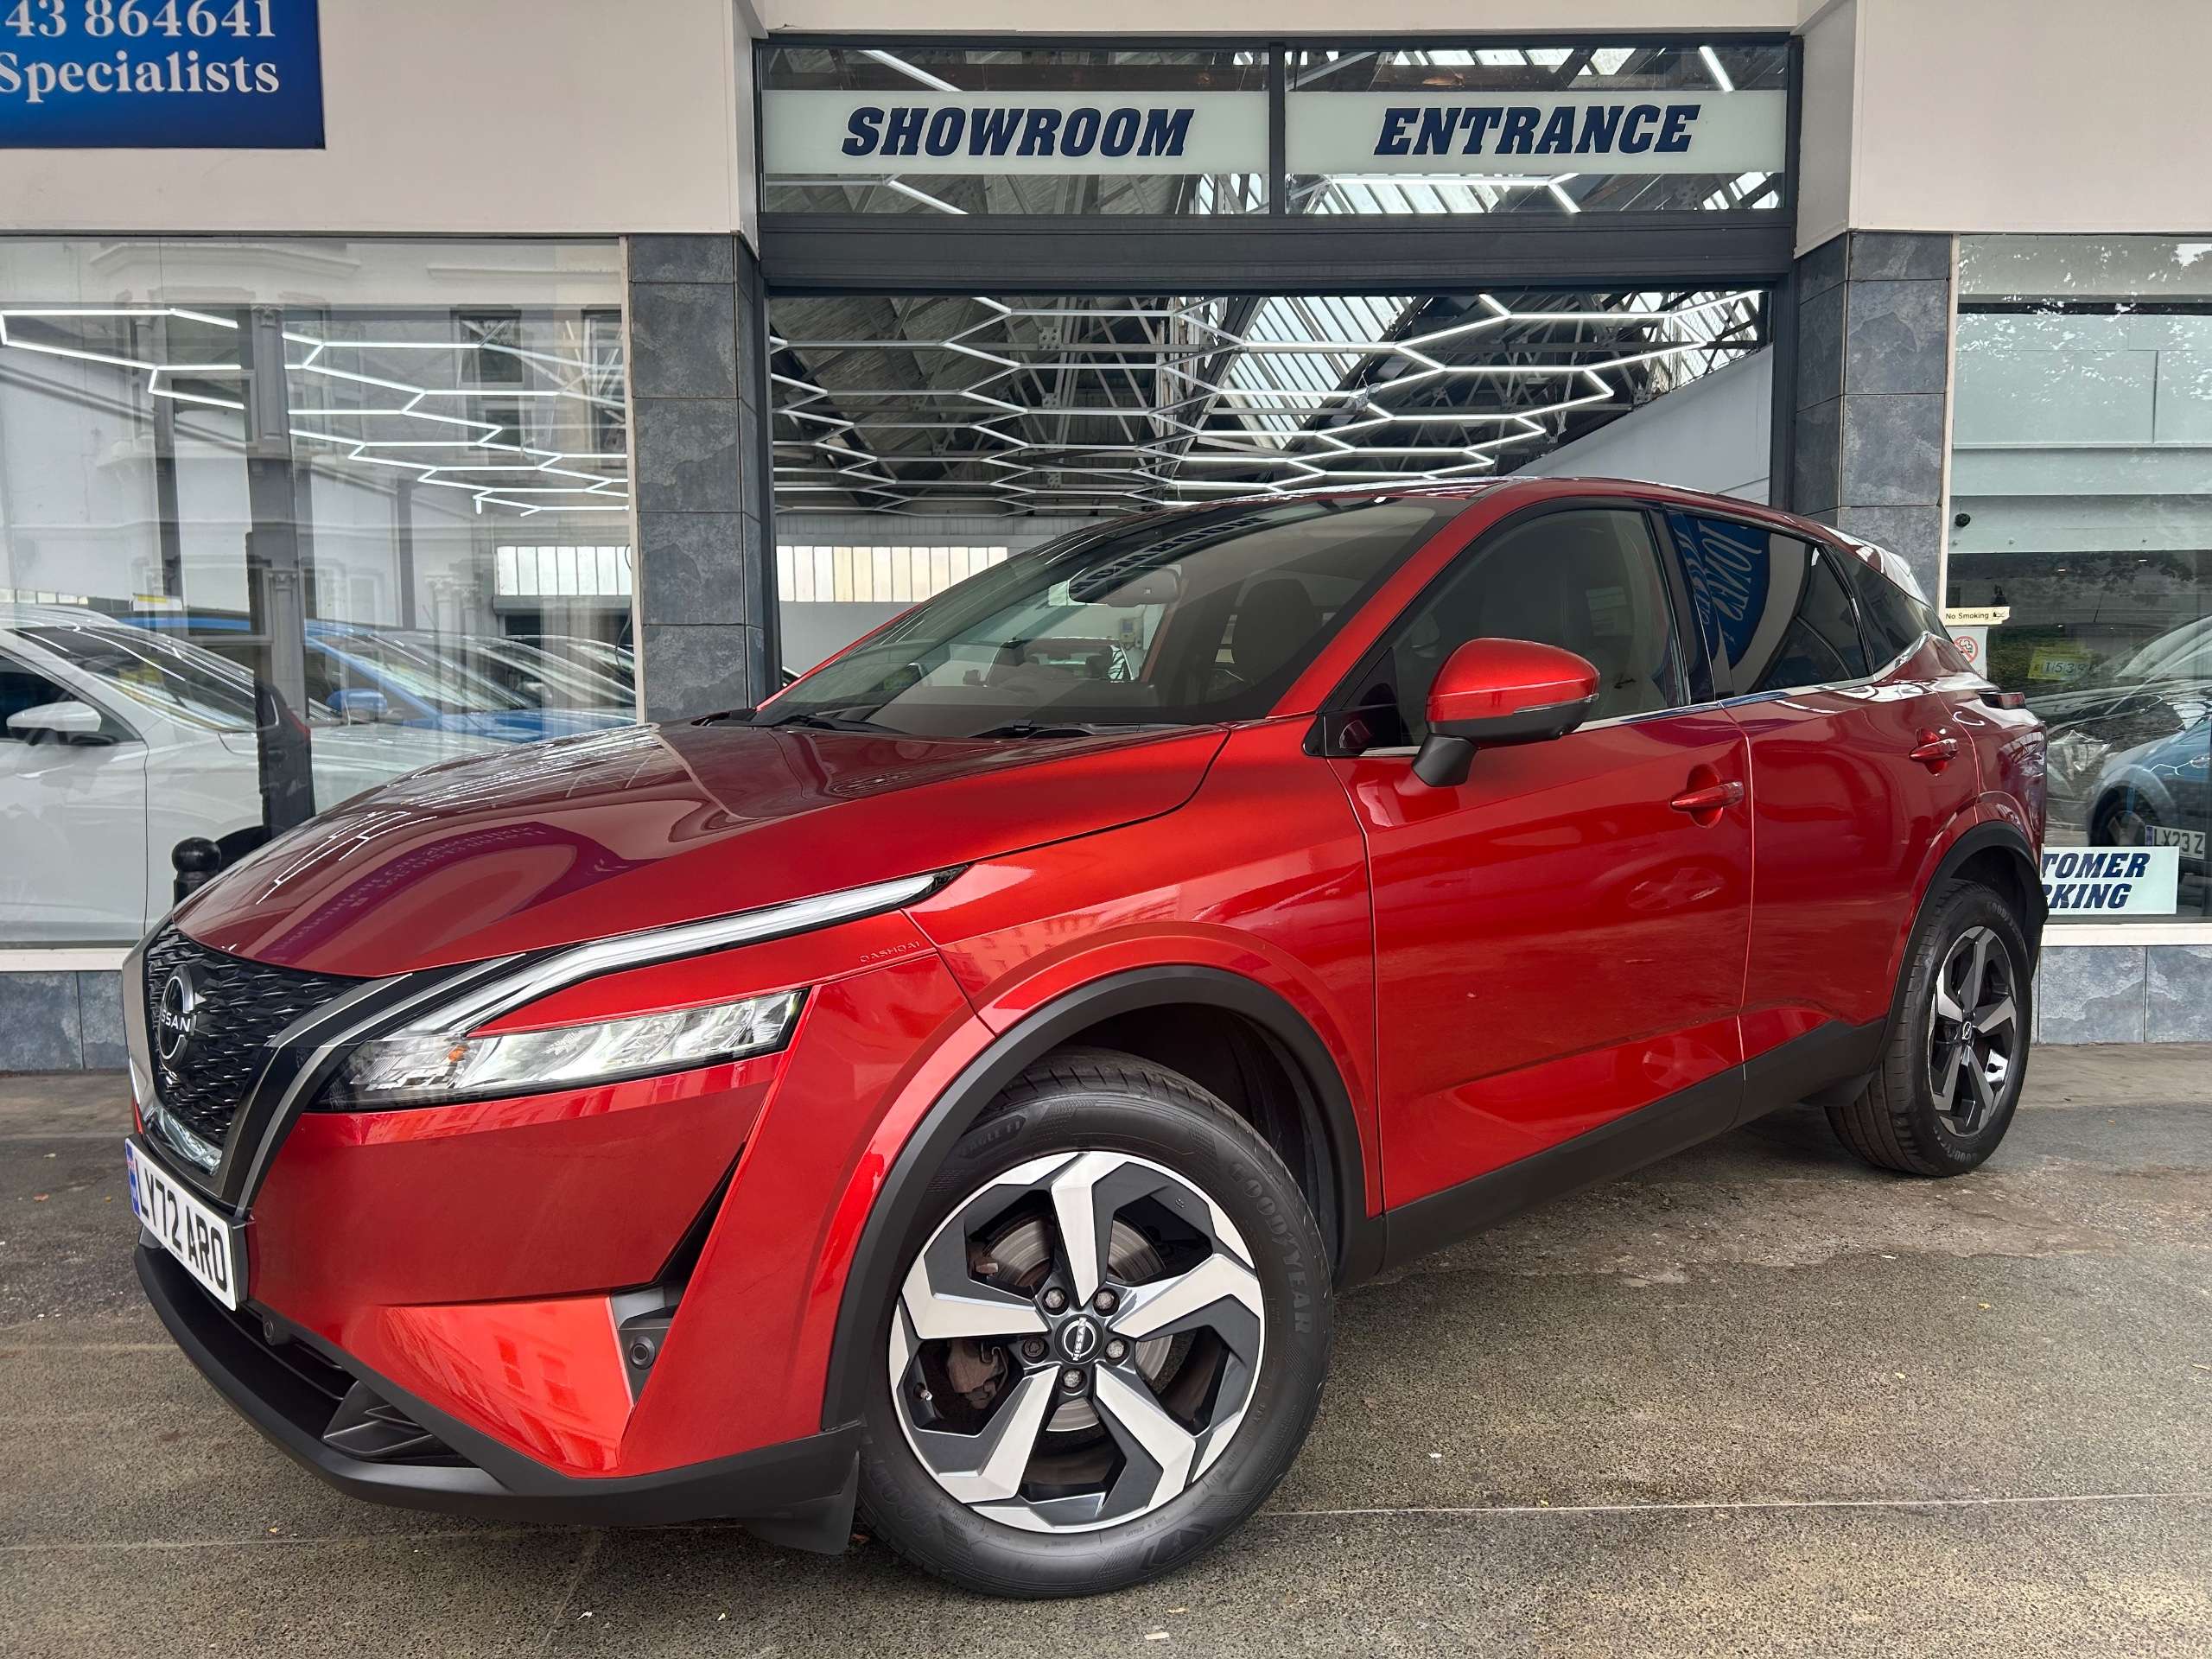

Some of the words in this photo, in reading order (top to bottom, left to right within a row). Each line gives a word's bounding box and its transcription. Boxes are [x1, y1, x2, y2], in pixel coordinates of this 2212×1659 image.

[5, 0, 67, 37] 43
[85, 0, 276, 37] 864641
[0, 50, 280, 104] Specialists
[841, 106, 1195, 157] SHOWROOM
[1373, 104, 1701, 156] ENTRANCE
[1958, 612, 1990, 620] Smoking
[2153, 828, 2190, 853] LX23
[2194, 834, 2204, 855] Z
[135, 1157, 182, 1252] LY72
[185, 1205, 228, 1294] ARO
[1072, 1317, 1087, 1362] NISSAN
